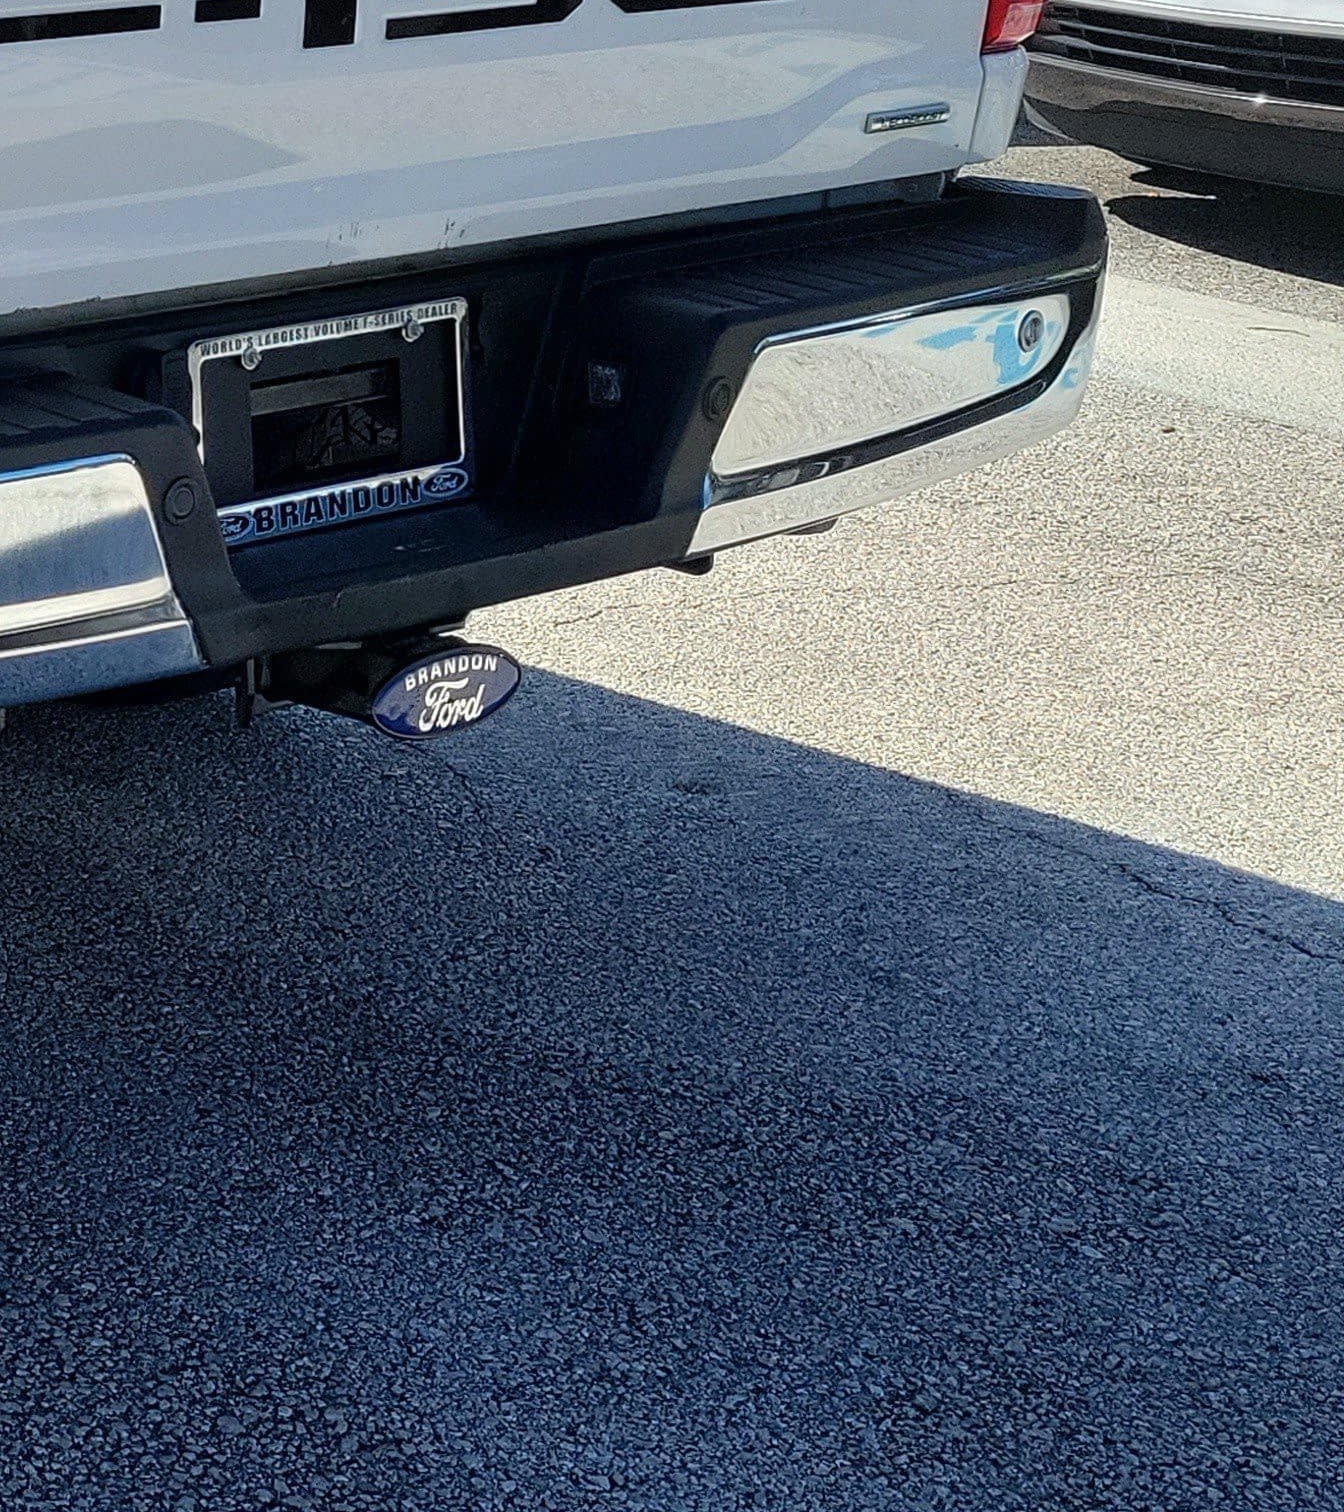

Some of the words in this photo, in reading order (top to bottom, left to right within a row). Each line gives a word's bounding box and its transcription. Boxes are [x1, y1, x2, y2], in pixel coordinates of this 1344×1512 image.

[200, 335, 254, 356] WORLD'S
[258, 327, 309, 348] LARGEST
[314, 319, 359, 339] VOLUME
[363, 310, 414, 331] F-SERIES
[417, 302, 458, 322] DEALER
[253, 476, 421, 535] BRANDON
[430, 474, 459, 492] Ford
[405, 654, 497, 691] BRANDON
[418, 677, 486, 732] Ford
